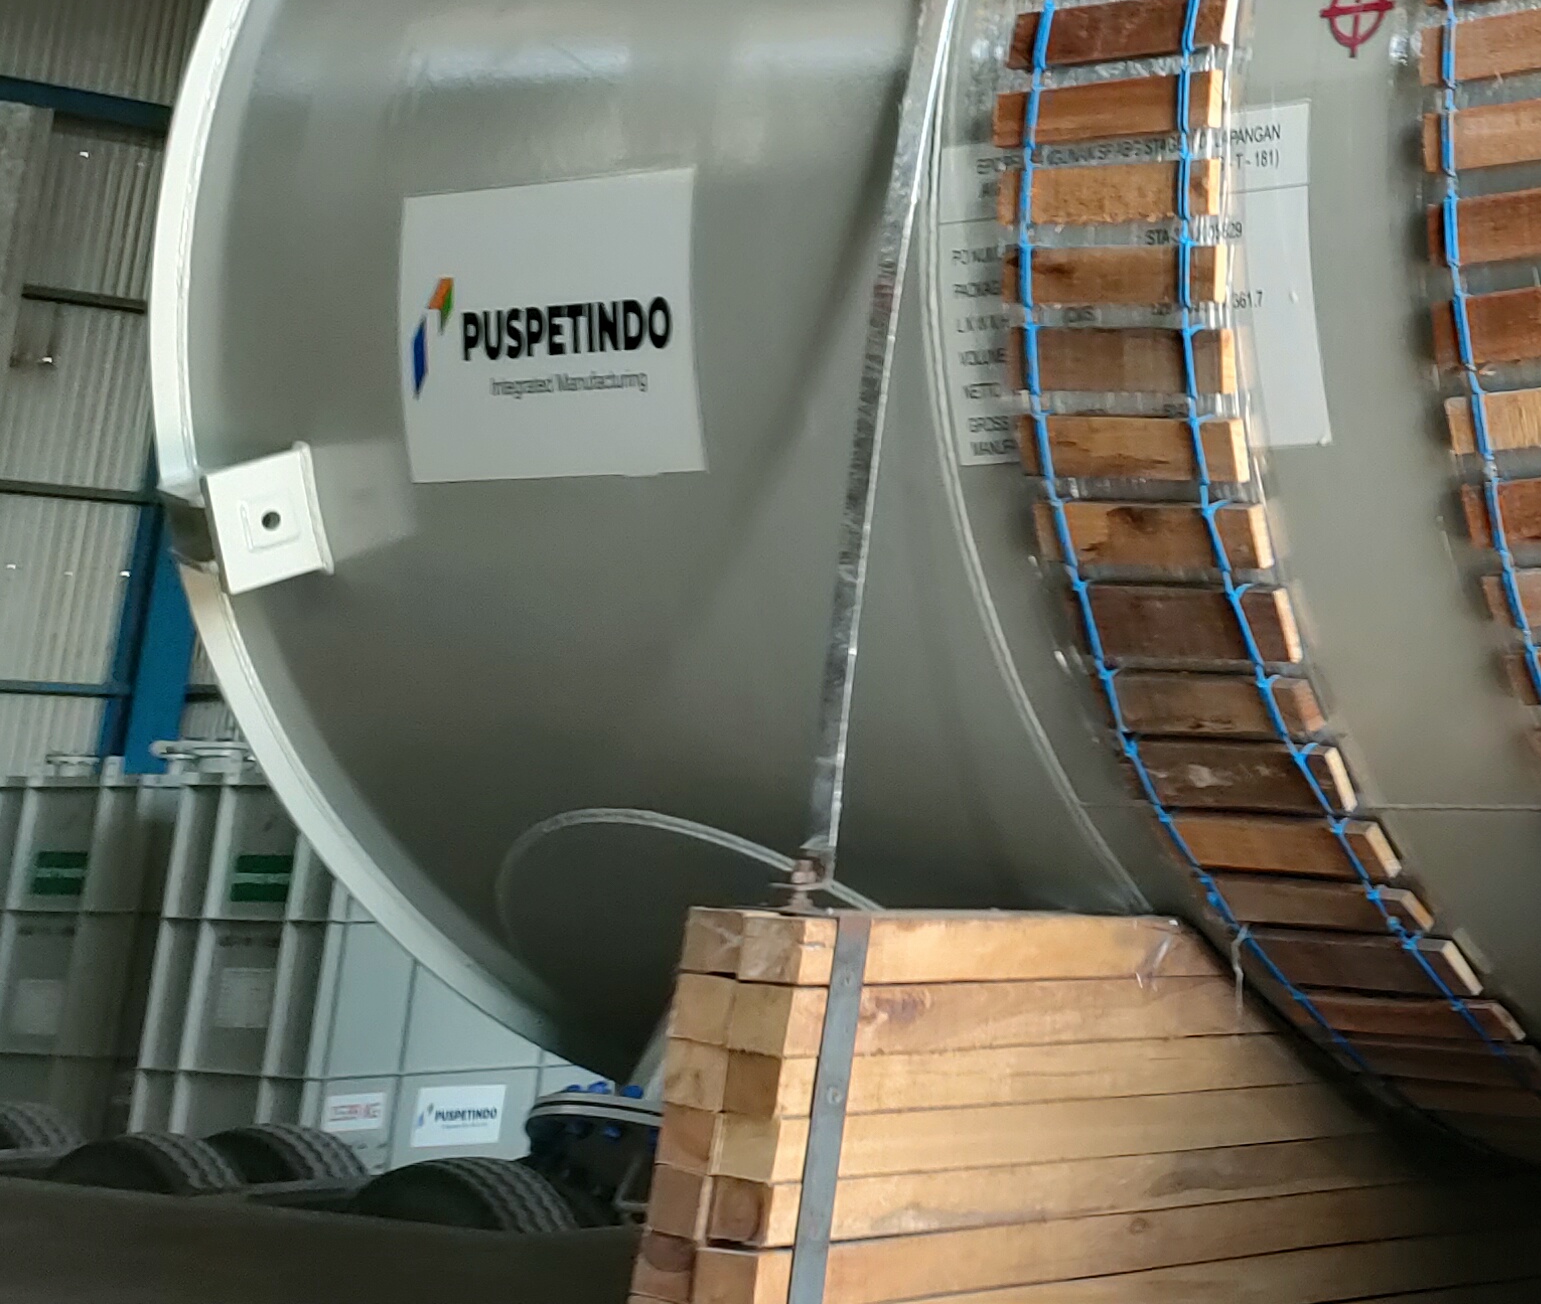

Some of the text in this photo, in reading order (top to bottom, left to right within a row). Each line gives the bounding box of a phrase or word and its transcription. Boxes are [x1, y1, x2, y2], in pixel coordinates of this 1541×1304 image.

[461, 296, 674, 362] PUSPETINDO
[490, 370, 648, 400] Integrated Manufacturing
[434, 1106, 497, 1122] PUSPETINDO
